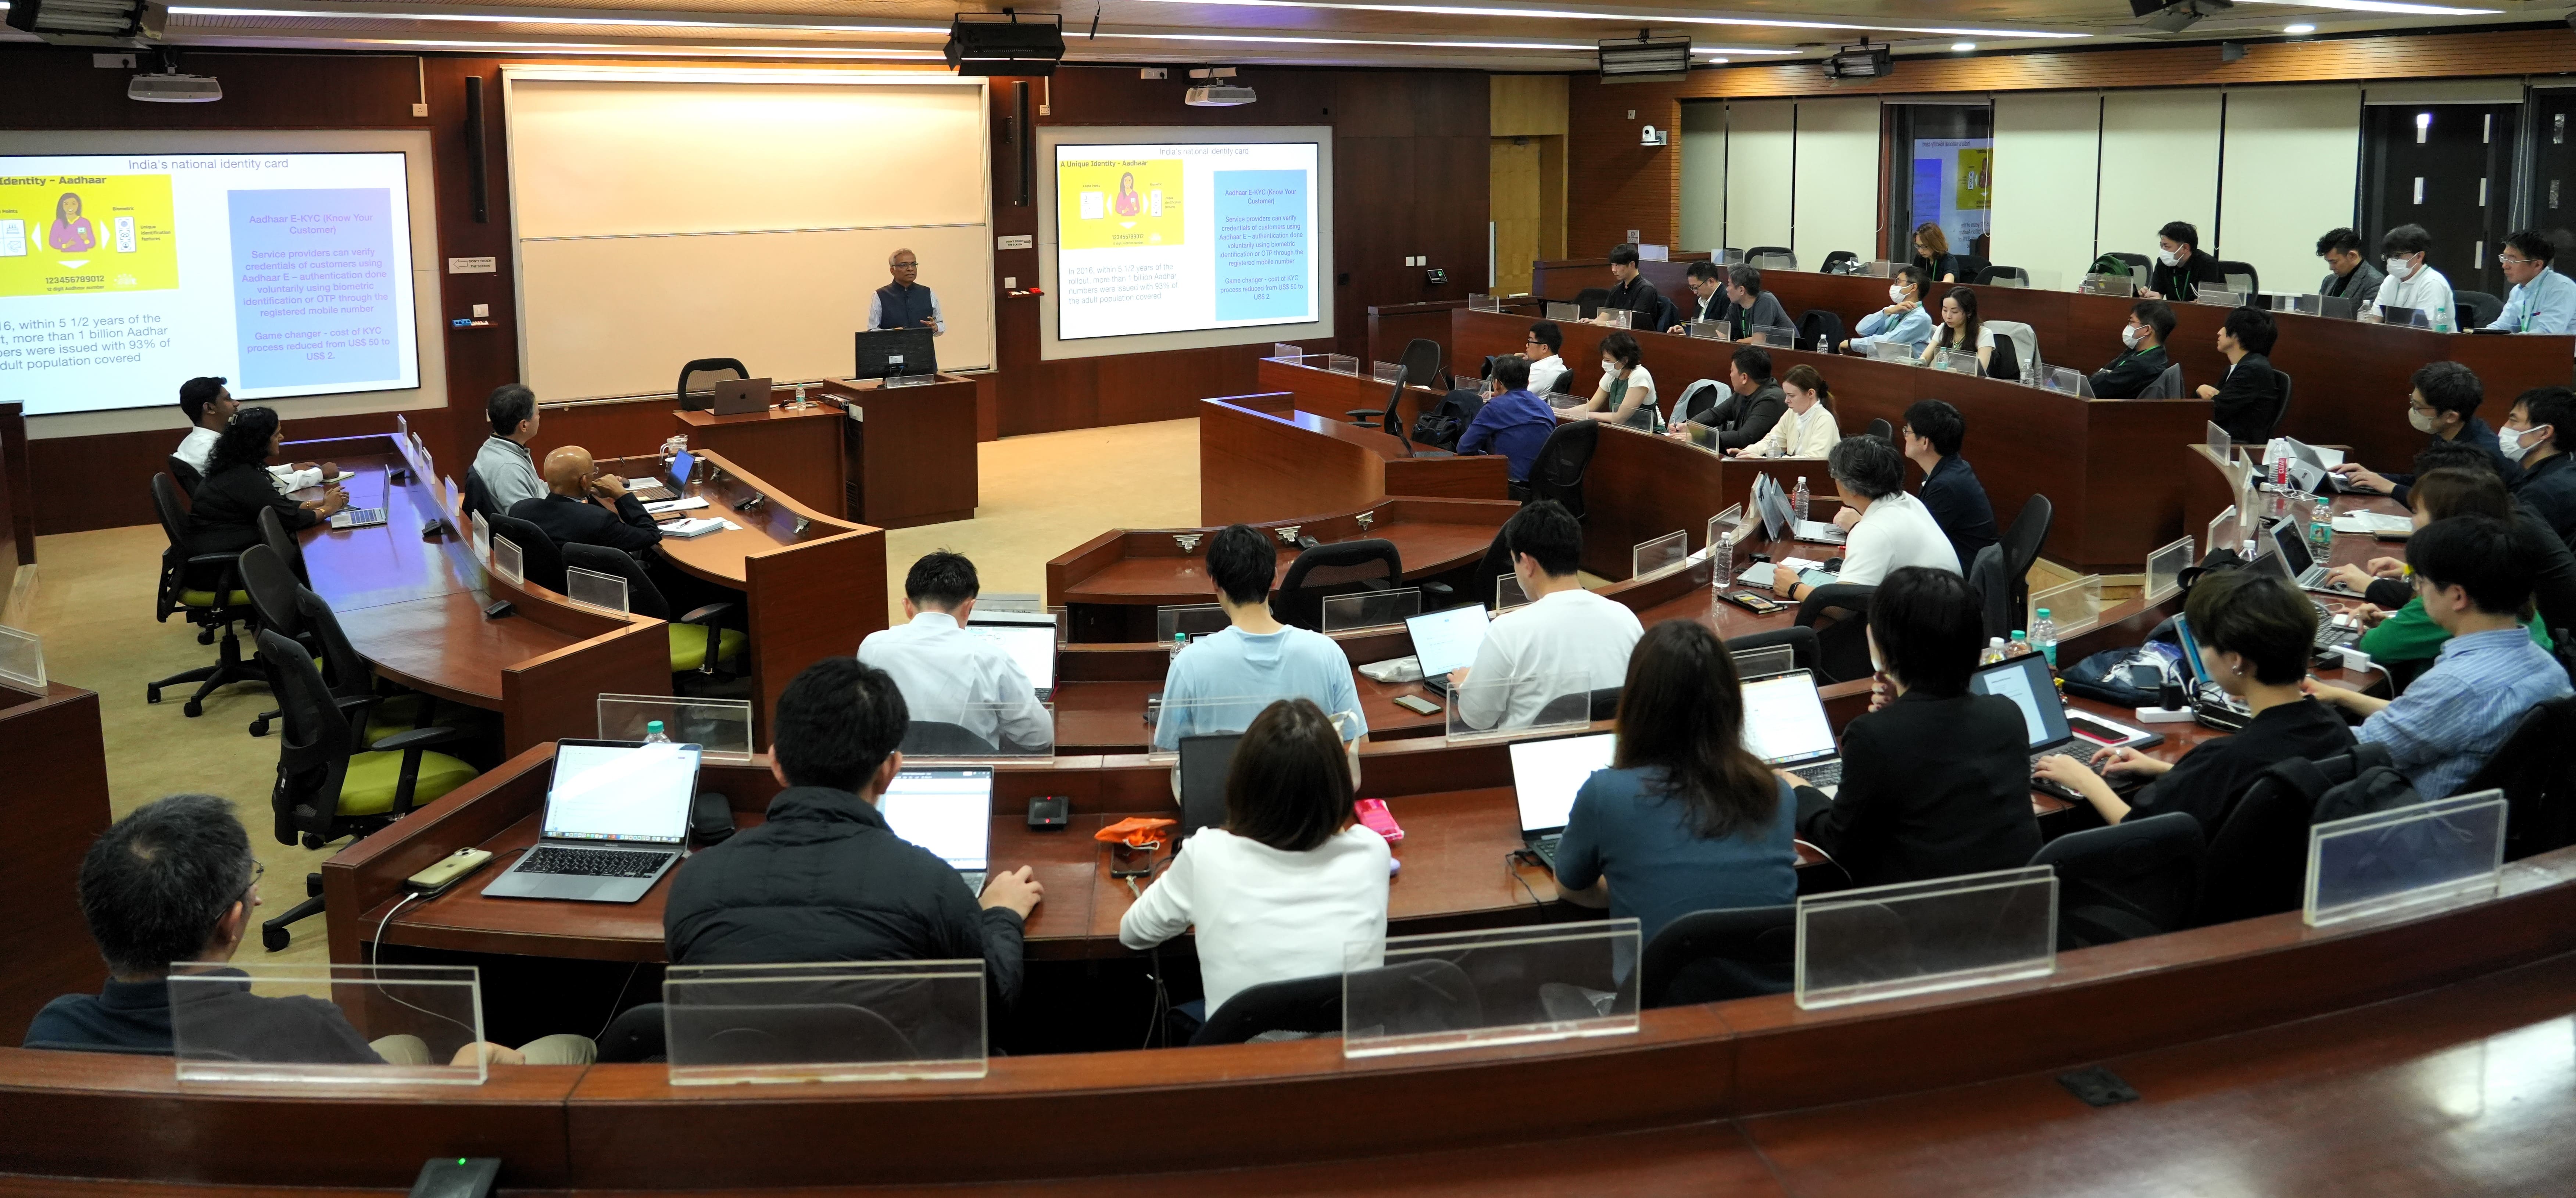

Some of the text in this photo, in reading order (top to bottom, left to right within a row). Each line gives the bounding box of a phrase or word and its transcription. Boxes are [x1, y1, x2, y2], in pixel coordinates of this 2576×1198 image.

[1210, 147, 1233, 156] identity
[129, 159, 288, 170] India's national identity card
[0, 177, 46, 186] Identity
[323, 214, 350, 223] (Know
[289, 226, 336, 234] Customer)
[251, 250, 285, 258] Service
[288, 250, 330, 259] providers
[351, 248, 375, 257] verify
[245, 262, 296, 270] credentials
[359, 259, 382, 268] using
[45, 275, 104, 284] 123456789012
[300, 271, 362, 280] authentication
[257, 282, 373, 293] voluntarily using biometric
[243, 296, 302, 305] identification
[316, 294, 336, 302] OTP
[338, 294, 372, 302] through
[1100, 295, 1134, 304] population
[260, 307, 305, 318] registered
[308, 306, 338, 314] mobile
[18, 319, 54, 329] within
[59, 318, 66, 327] 5
[71, 317, 89, 326] 1/2
[93, 318, 124, 328] years
[128, 314, 139, 323] of
[143, 314, 160, 323] the
[47, 332, 74, 341] than
[79, 330, 83, 339] 1
[89, 329, 123, 338] billion
[127, 327, 168, 336] Aadhar
[285, 331, 321, 339] changer
[26, 338, 170, 355] were issued with 93% of
[247, 345, 284, 354] process
[286, 341, 323, 349] reduced
[348, 338, 366, 347] US$
[27, 356, 90, 370] population
[94, 353, 140, 364] covered
[306, 352, 325, 360] US$
